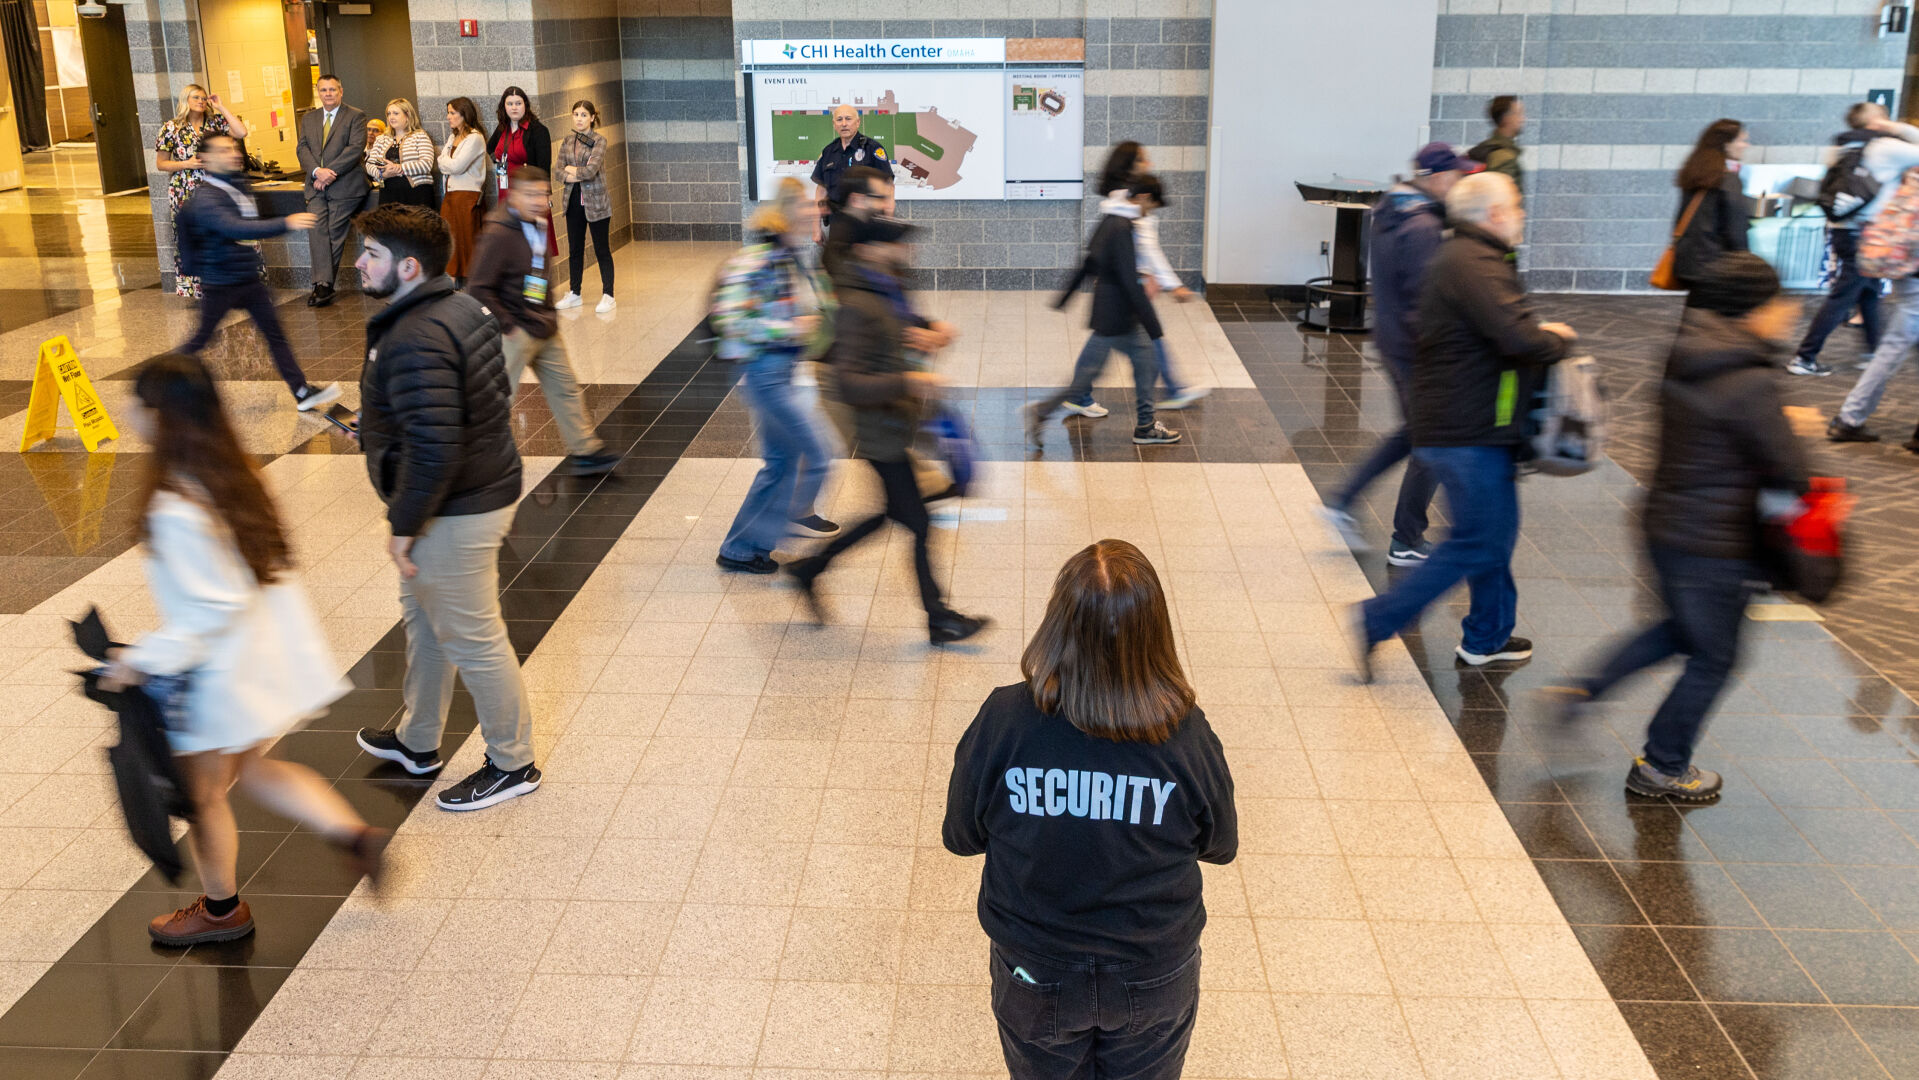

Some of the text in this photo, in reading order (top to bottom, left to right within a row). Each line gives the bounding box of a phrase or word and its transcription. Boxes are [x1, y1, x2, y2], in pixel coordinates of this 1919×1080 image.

[801, 44, 975, 58] CHI Health Center OMAHA
[1005, 766, 1176, 825] SECURITY
